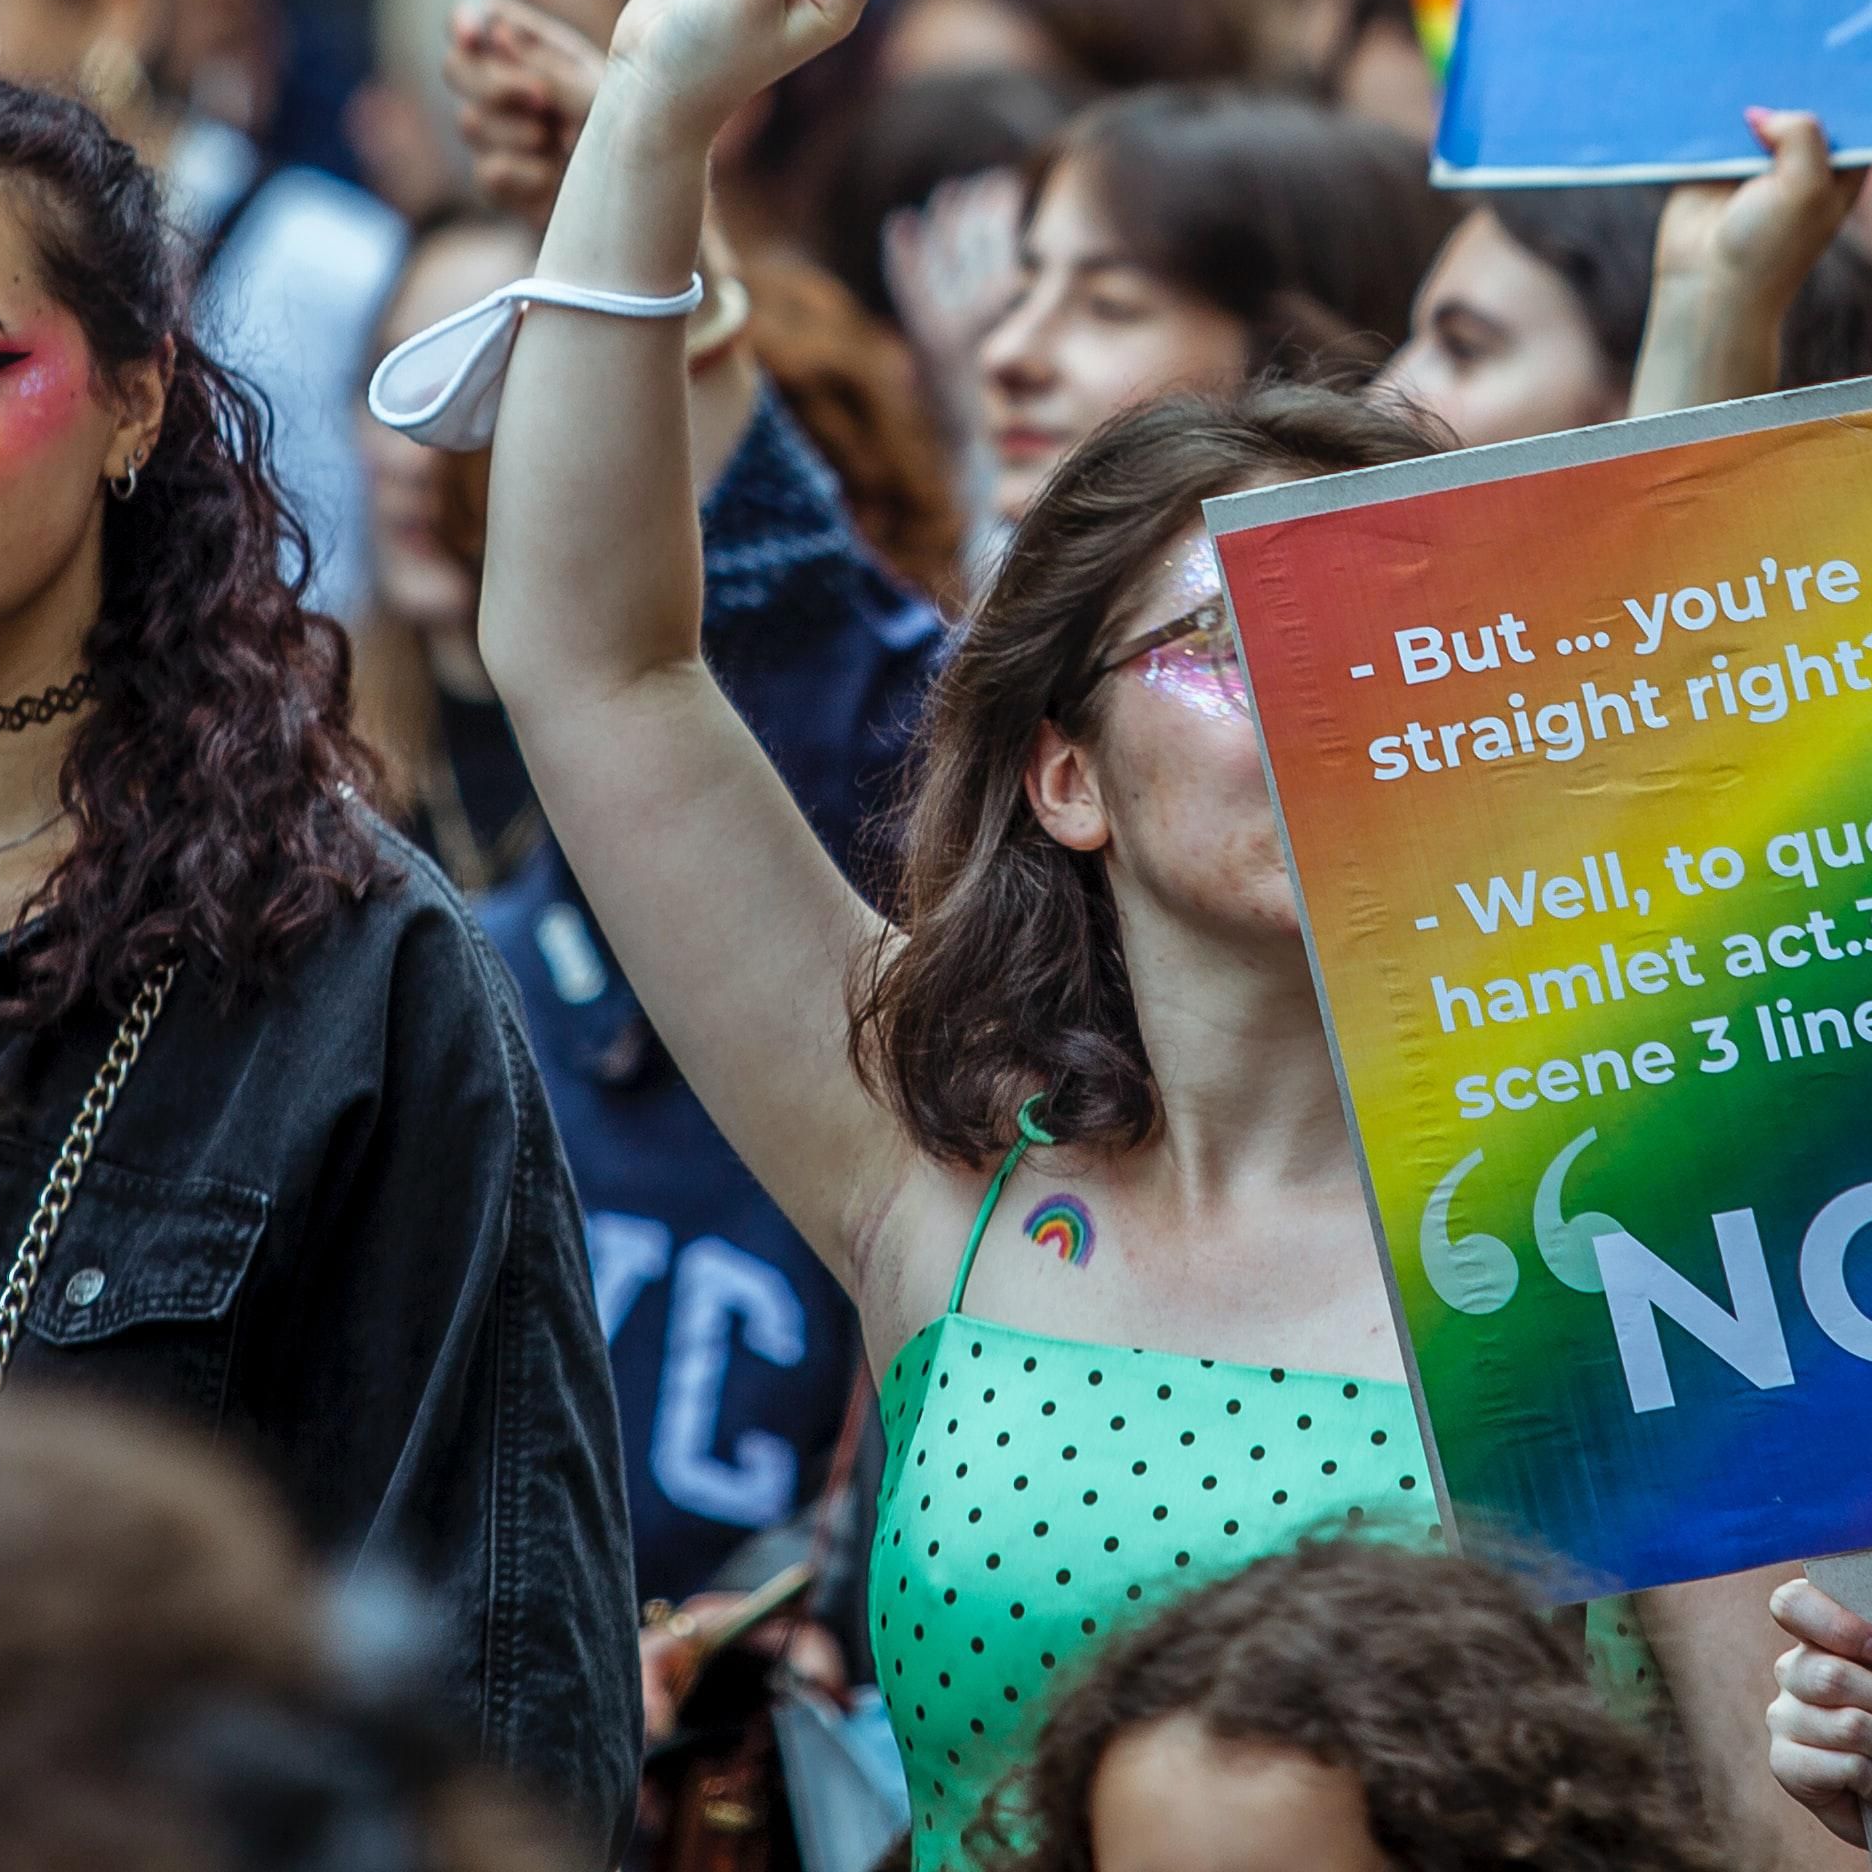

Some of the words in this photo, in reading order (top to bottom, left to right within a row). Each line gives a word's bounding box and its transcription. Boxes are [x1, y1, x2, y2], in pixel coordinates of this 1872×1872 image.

[1393, 611, 1536, 686] But
[1623, 555, 1861, 654] you're
[1368, 675, 1668, 781] straight
[1455, 851, 1652, 937] Well,
[1665, 843, 1746, 897] to
[1431, 934, 1705, 1032] hamlet
[1455, 1038, 1677, 1119] scene
[1700, 1015, 1742, 1075] 3
